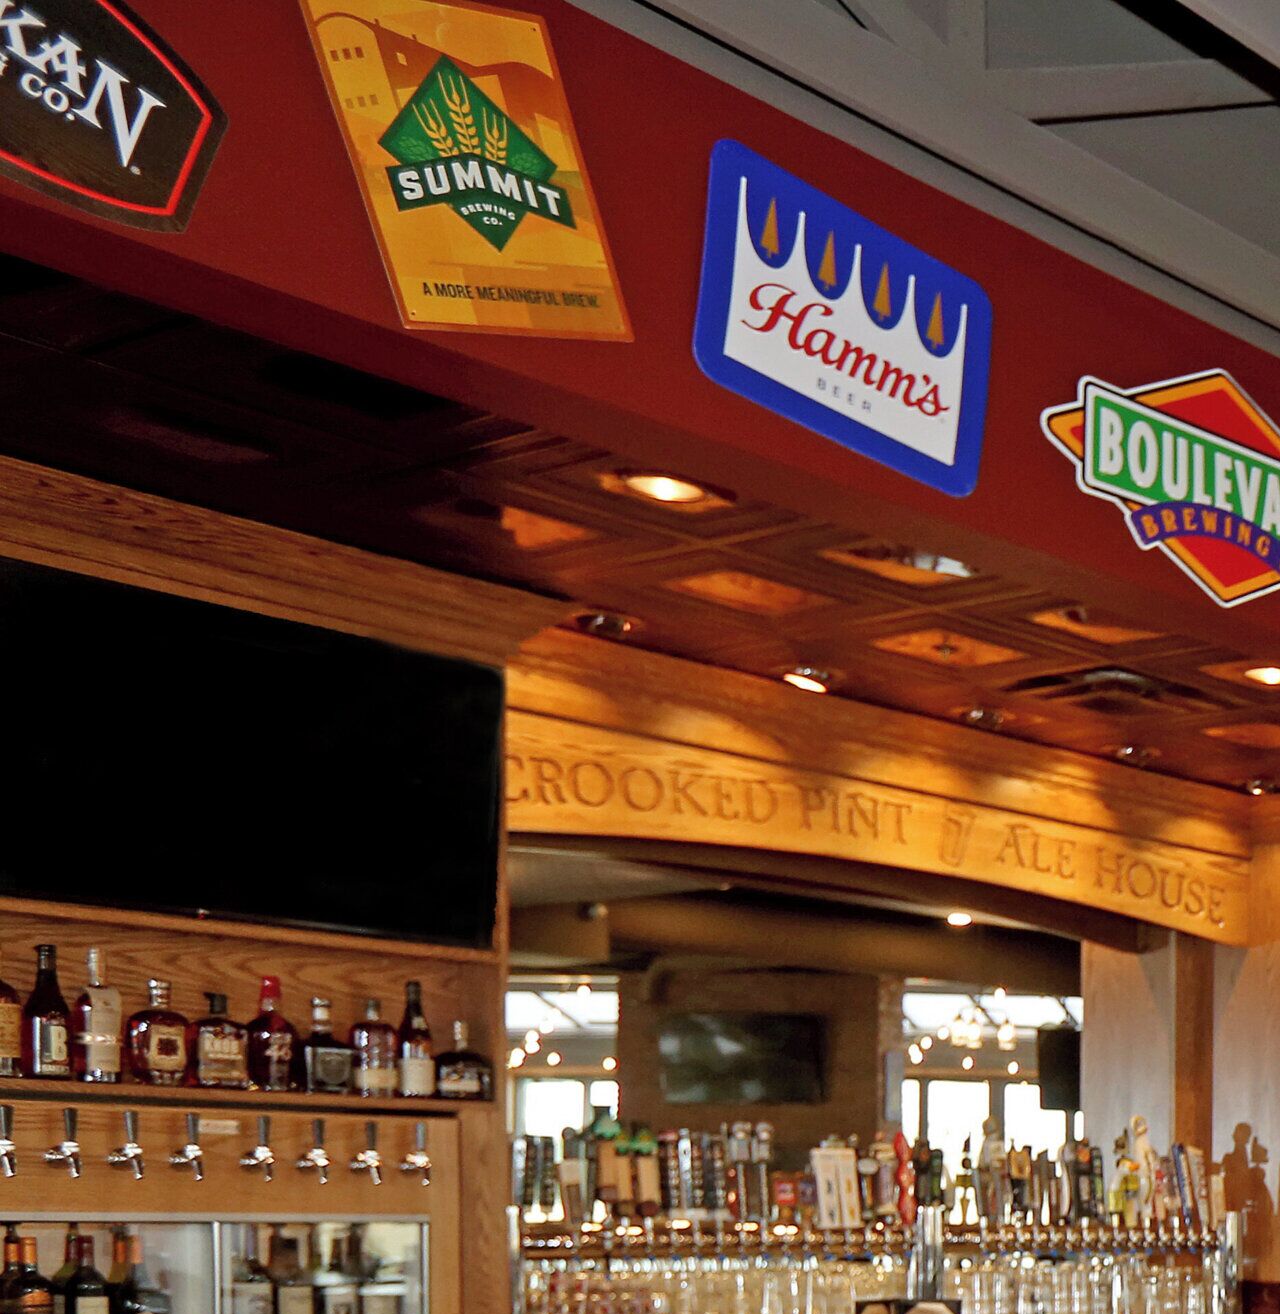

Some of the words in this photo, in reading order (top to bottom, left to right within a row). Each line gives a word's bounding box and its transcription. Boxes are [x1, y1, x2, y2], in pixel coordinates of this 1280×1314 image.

[20, 72, 75, 121] CO.
[398, 160, 561, 216] SUMMIT
[460, 202, 516, 221] BREWING
[483, 216, 503, 226] CO.
[422, 282, 433, 296] A
[434, 283, 474, 299] MORE
[475, 286, 561, 305] MEANINGFUL
[741, 283, 950, 417] Hamm's
[817, 377, 872, 413] BEER
[1140, 507, 1270, 557] BREWING
[505, 755, 778, 824] CROOKED
[797, 783, 913, 845] PINT
[996, 823, 1076, 880] ALE
[1094, 847, 1226, 928] HOUSE
